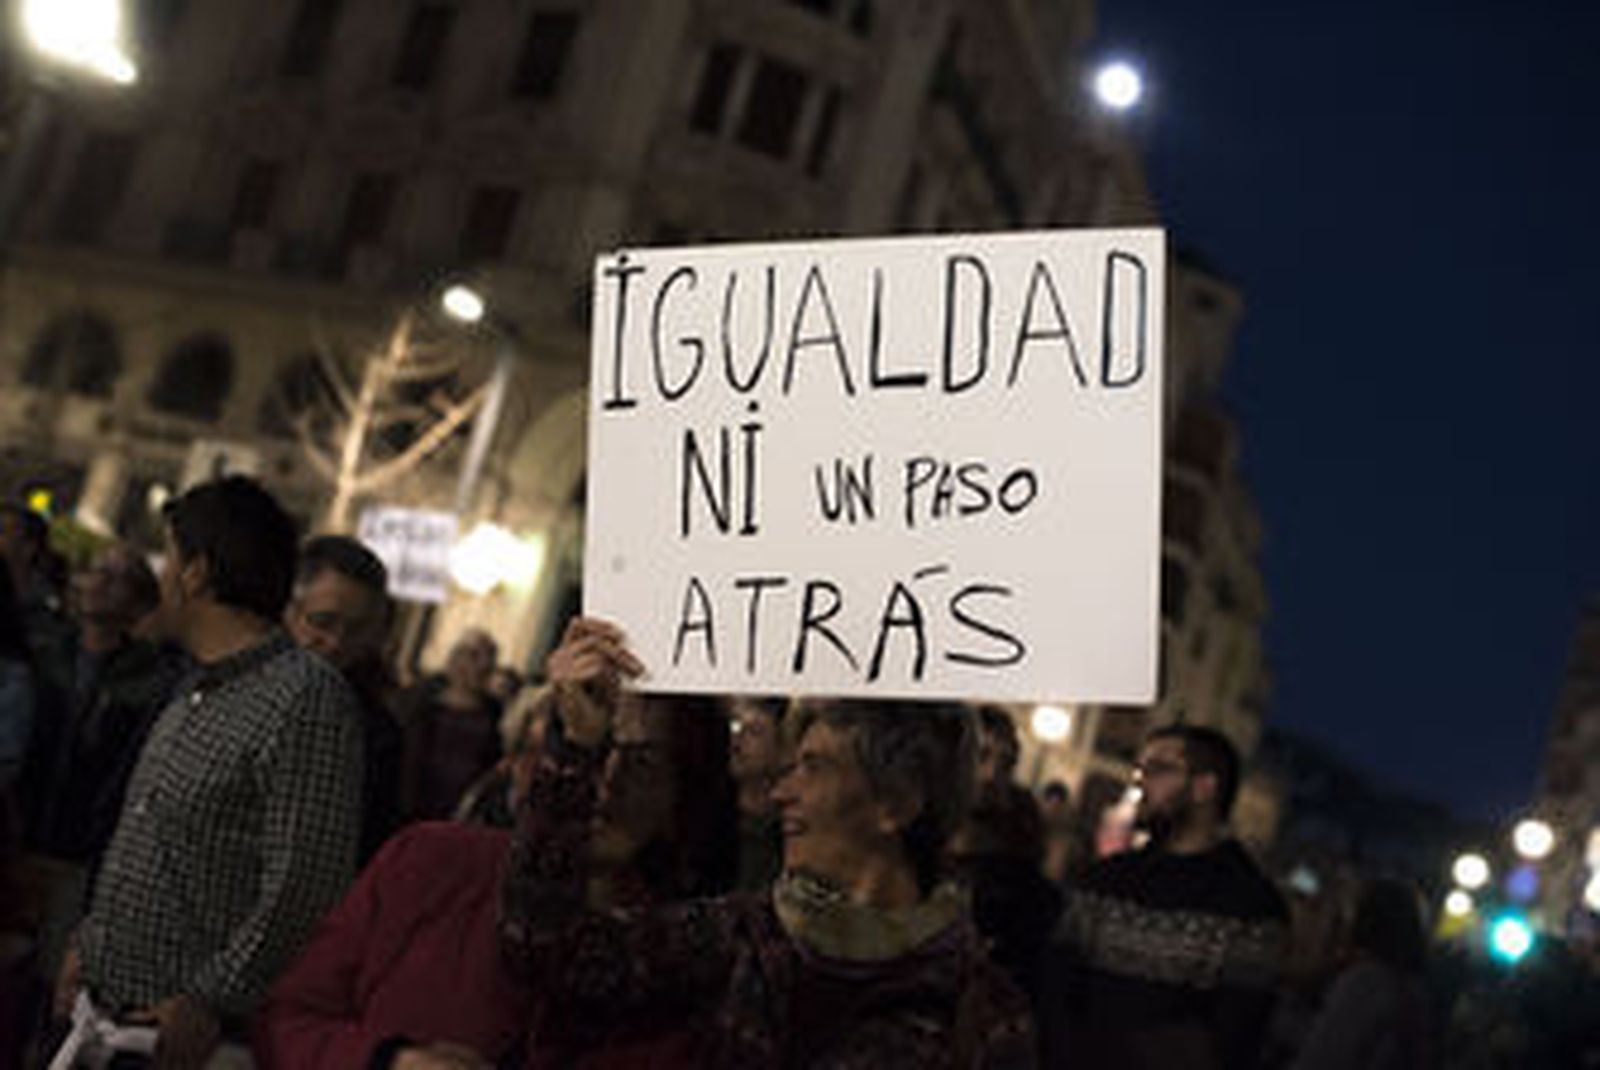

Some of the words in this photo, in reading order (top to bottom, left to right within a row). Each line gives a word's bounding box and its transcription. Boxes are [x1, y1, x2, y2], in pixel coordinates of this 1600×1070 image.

[815, 456, 876, 525] UN
[904, 457, 1039, 528] PASO
[672, 565, 1026, 682] ATRÁS
